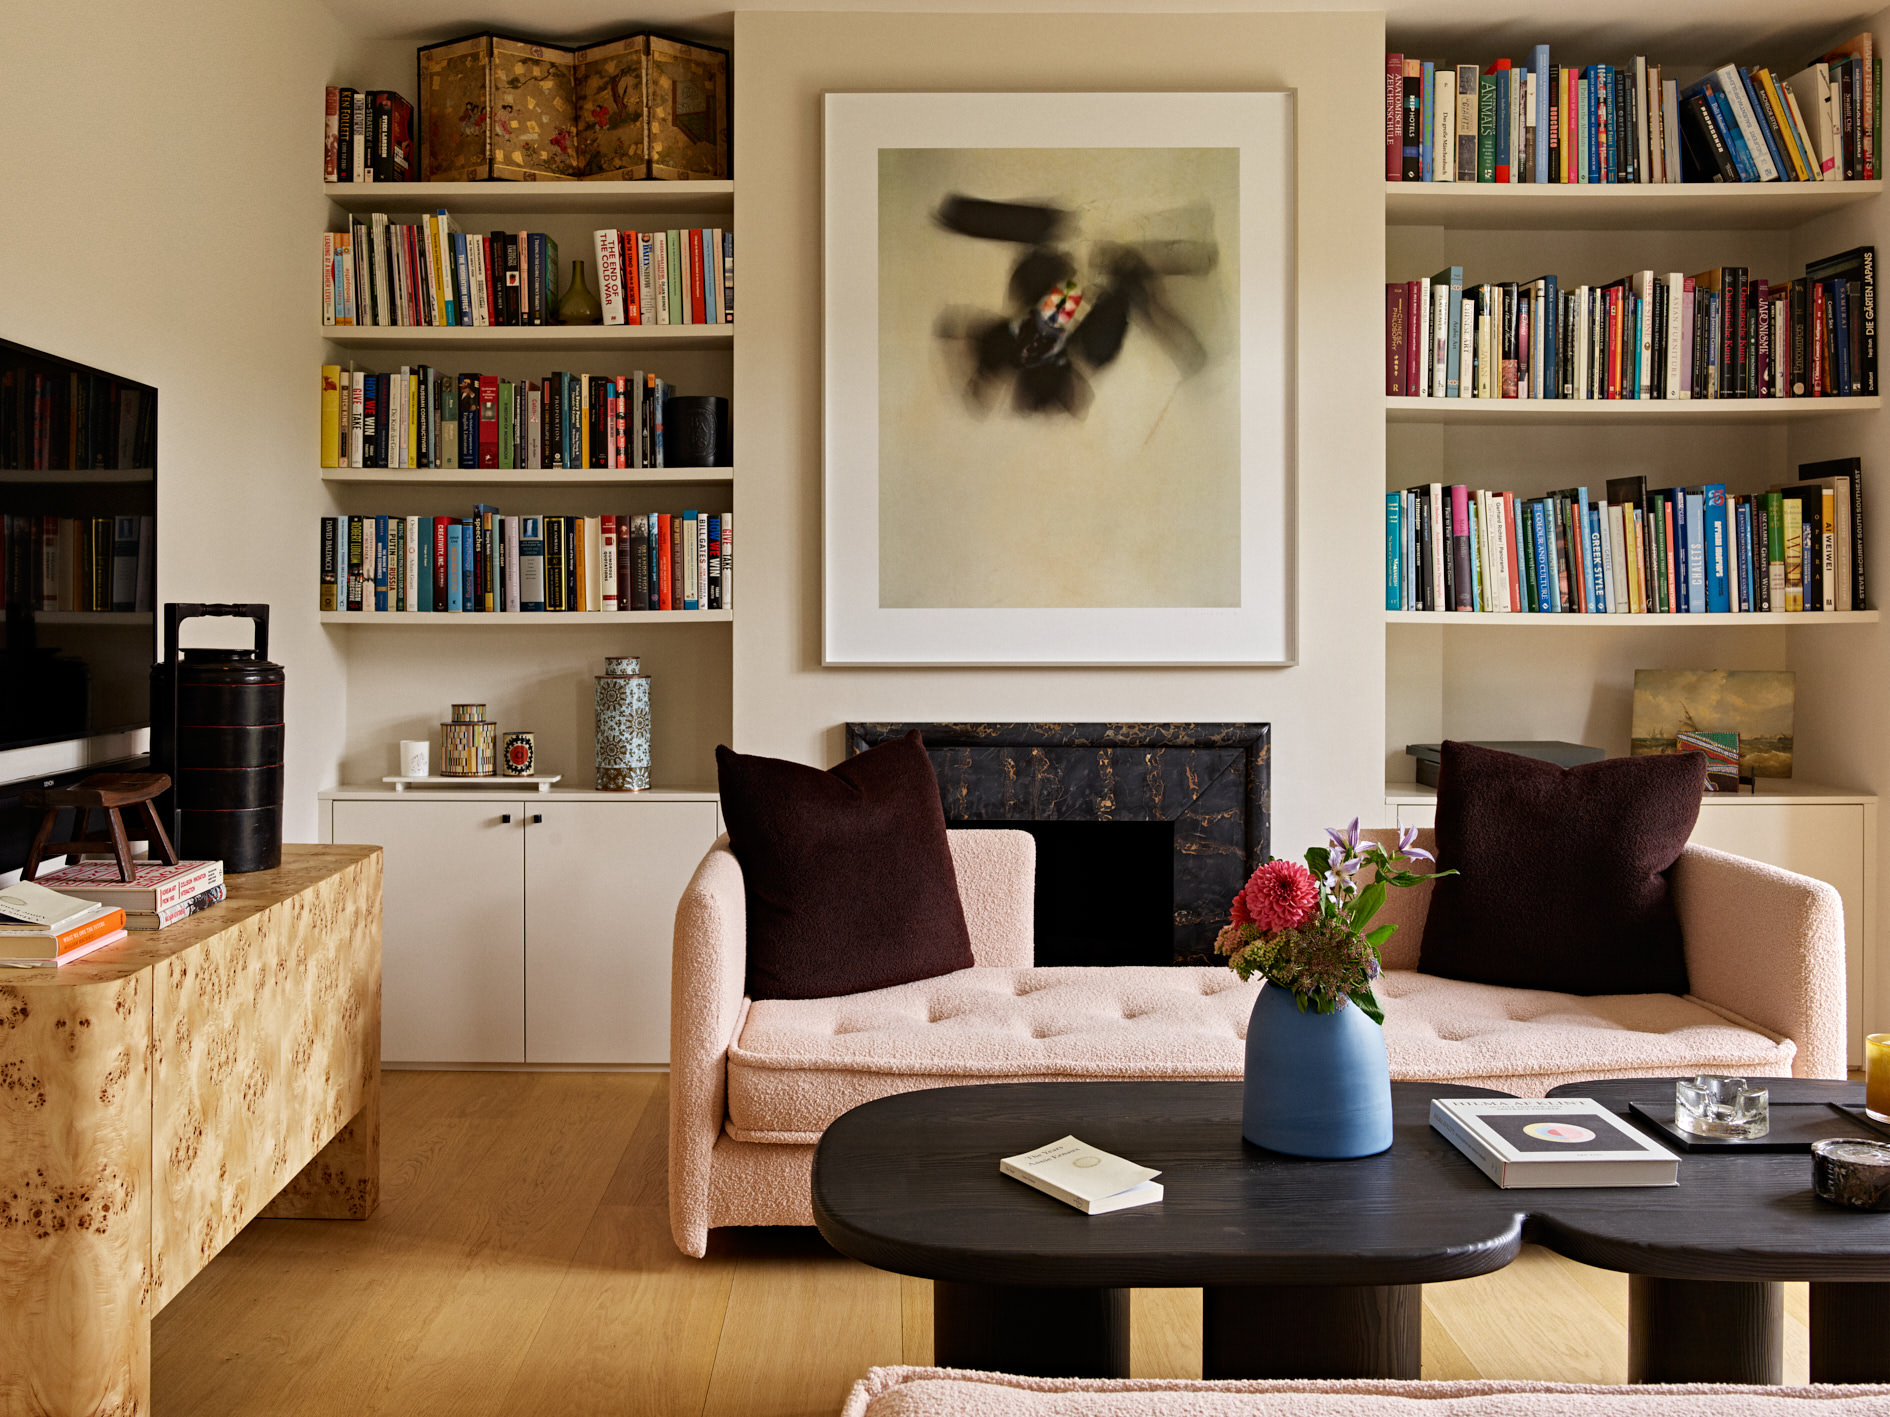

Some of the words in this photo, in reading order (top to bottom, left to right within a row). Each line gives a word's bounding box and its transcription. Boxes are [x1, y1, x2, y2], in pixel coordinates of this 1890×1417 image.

[341, 92, 352, 107] KEN
[1617, 75, 1625, 106] planet
[1865, 74, 1873, 113] TESTINO
[355, 98, 364, 135] OCTOPUS
[1386, 73, 1394, 145] ZEICHENSCHULE
[1481, 81, 1496, 136] ANIMALS
[1760, 89, 1772, 115] BACHELOR
[1768, 113, 1779, 130] STYLE
[340, 109, 350, 141] FOLLETT
[1700, 106, 1724, 153] PROPAGANDA
[1865, 115, 1873, 170] PORTRAITS
[599, 233, 608, 252] THE
[608, 240, 617, 259] THE
[601, 255, 610, 282] COLD
[609, 262, 618, 282] END
[1864, 252, 1873, 285] JAPANS
[604, 283, 612, 306] WAR
[611, 284, 619, 297] OF
[1864, 286, 1874, 320] GÄRTEN
[1671, 296, 1679, 322] ASIAN
[1725, 287, 1733, 338] Ostasiatische
[1739, 287, 1748, 338] Ostasiatische
[1759, 298, 1769, 355] JAPONISME
[1866, 322, 1874, 336] DIE
[1670, 326, 1678, 378] FURNITURE
[1725, 339, 1733, 364] Kunst
[1739, 339, 1747, 364] Kunst
[352, 388, 362, 405] GIVE
[364, 377, 376, 399] HOW
[364, 400, 376, 415] WE
[352, 413, 362, 430] TAKE
[364, 416, 376, 436] WIN
[1854, 469, 1862, 512] SOUTHEAST
[325, 520, 333, 539] DAVID
[709, 518, 720, 540] HOW
[1536, 512, 1544, 544] COLOUR
[1762, 513, 1768, 522] OZ
[1826, 523, 1832, 532] AI
[351, 522, 362, 542] ROBERT
[437, 524, 445, 556] CREATIVITY,
[474, 518, 482, 552] speeches
[722, 528, 732, 545] GIVE
[325, 541, 333, 571] BALDACCI
[351, 543, 361, 564] LUDLUM
[709, 541, 720, 557] WE
[1591, 532, 1602, 565] GREEK
[709, 558, 720, 577] WIN
[722, 554, 732, 571] TAKE
[1690, 544, 1702, 585] CHALETS
[1539, 564, 1549, 600] CULTURE
[1594, 567, 1604, 596] STYLE
